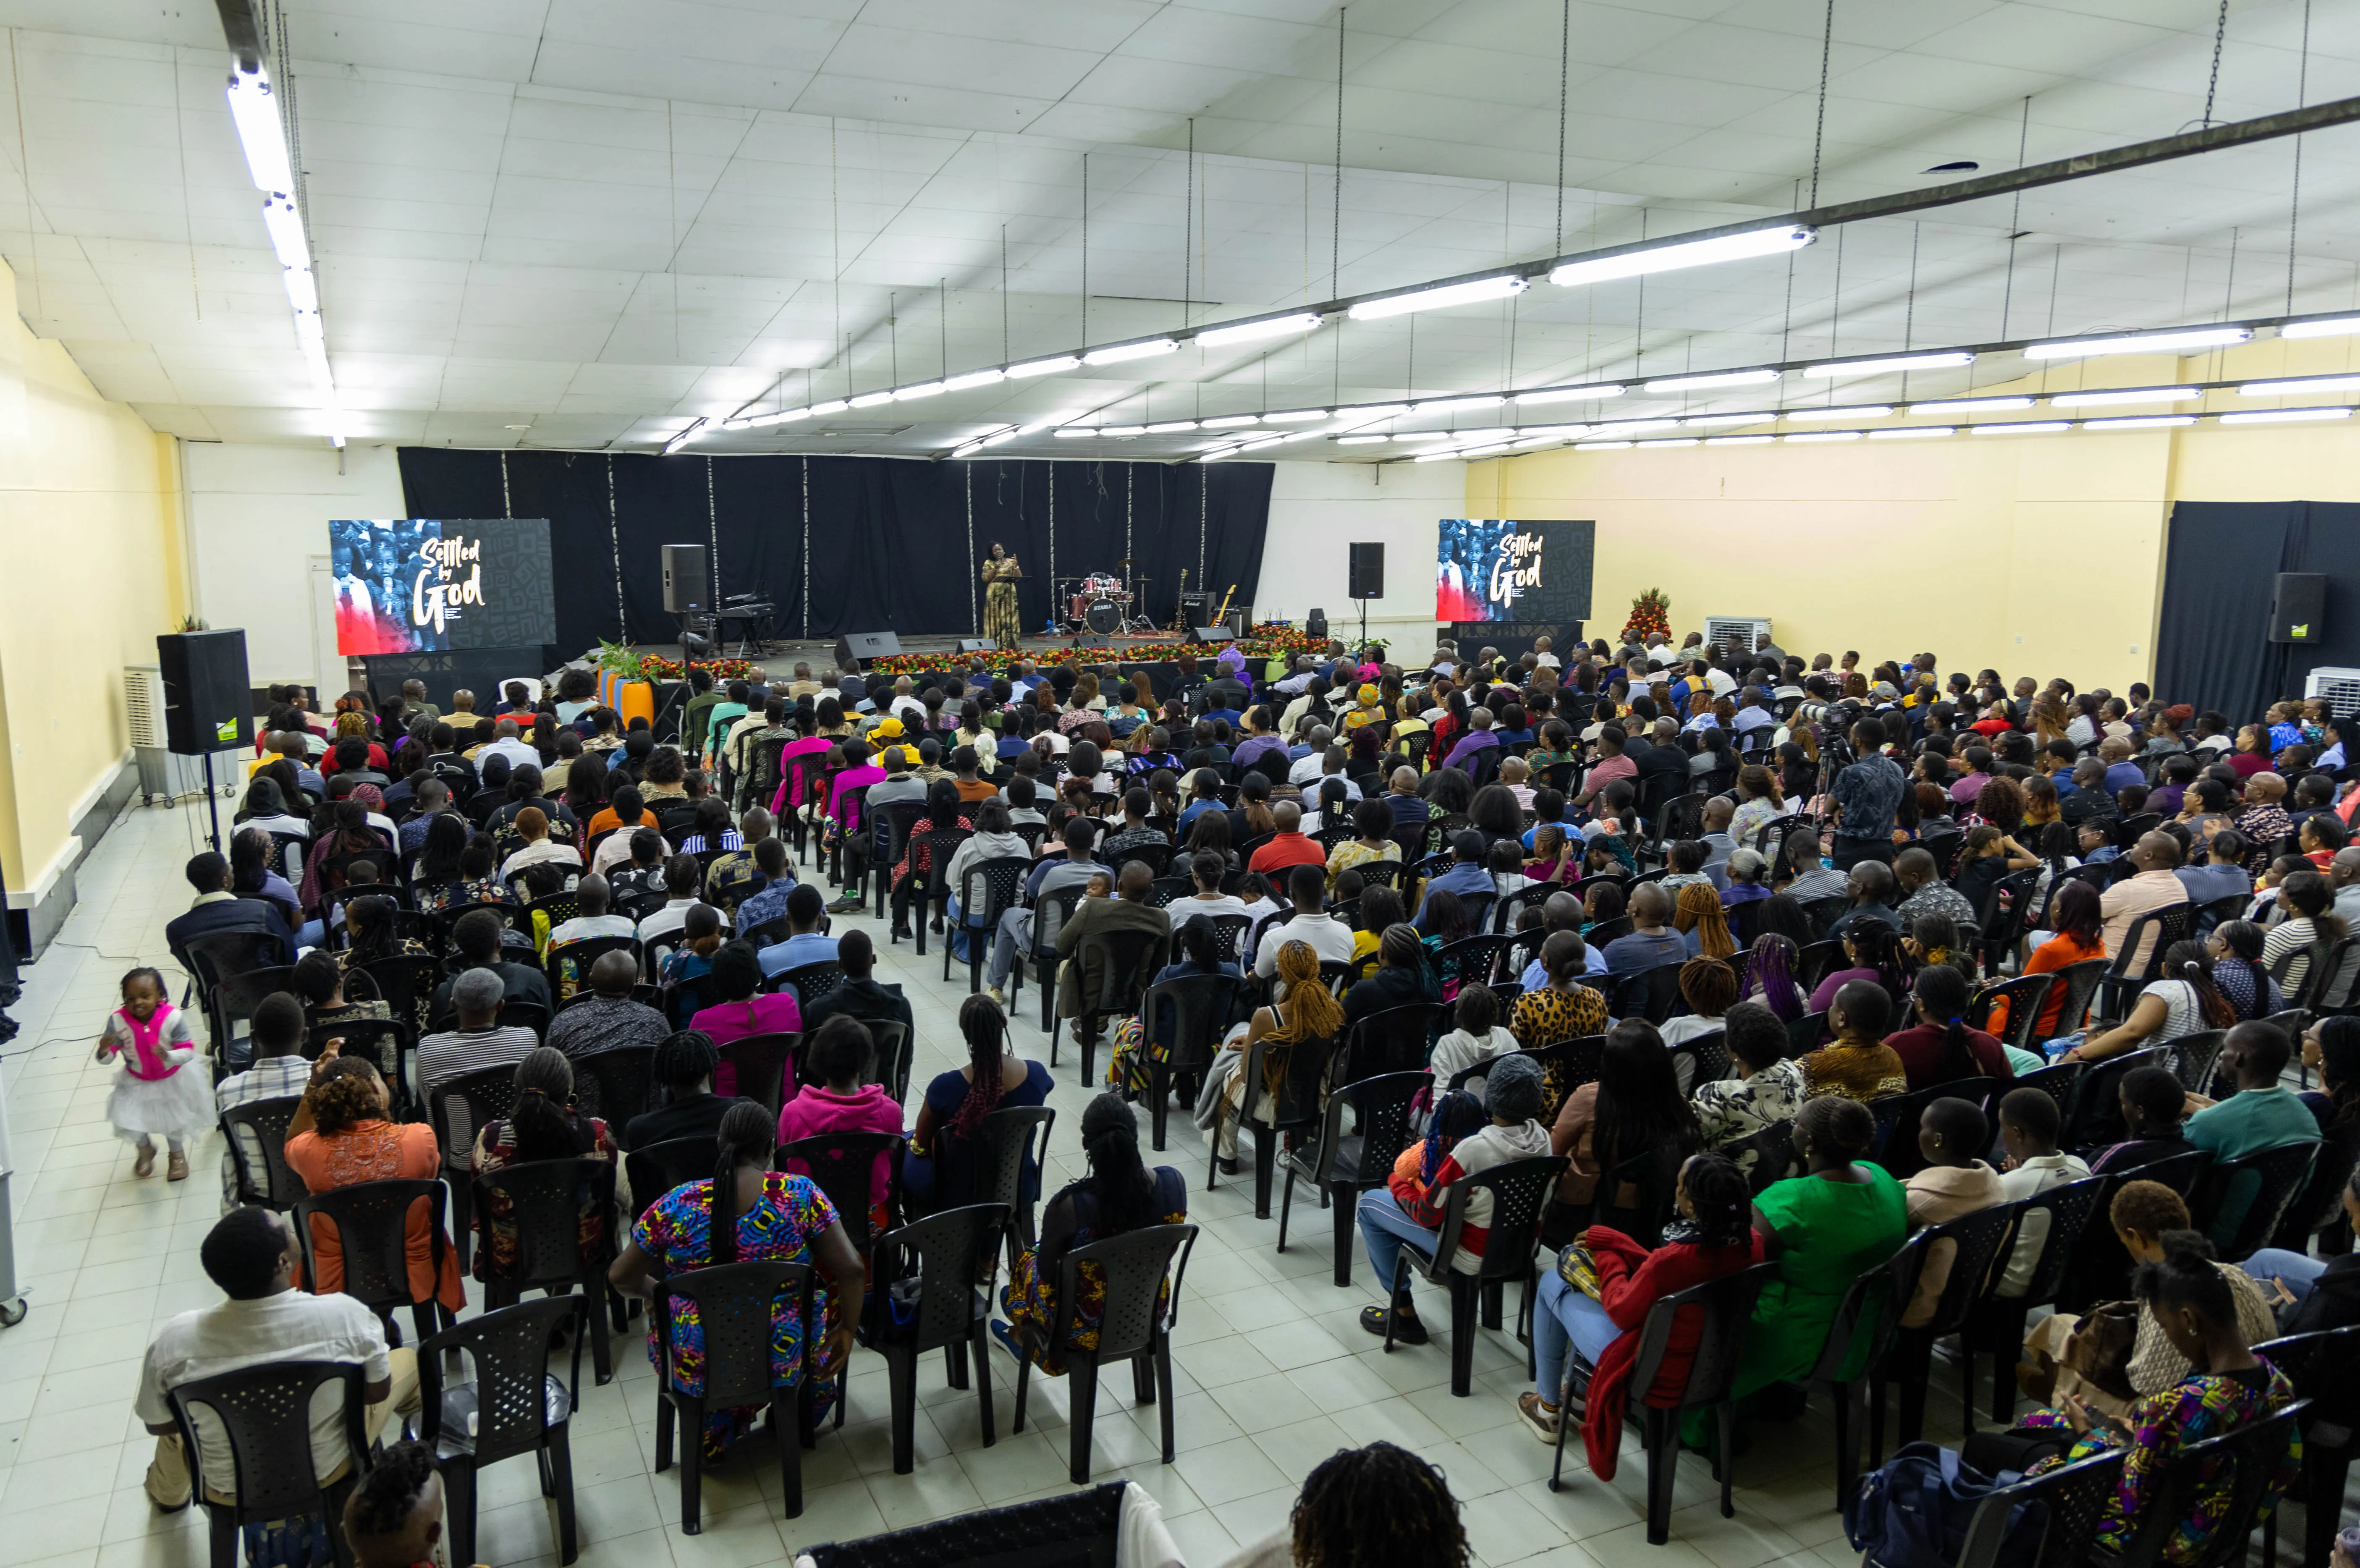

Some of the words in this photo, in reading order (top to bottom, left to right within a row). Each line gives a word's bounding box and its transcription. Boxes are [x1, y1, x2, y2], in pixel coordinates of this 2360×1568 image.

[420, 535, 480, 568] Settled
[1499, 532, 1543, 558] Settled
[438, 564, 452, 581] by
[1510, 554, 1521, 568] by
[1490, 554, 1543, 609] God
[413, 563, 486, 635] God
